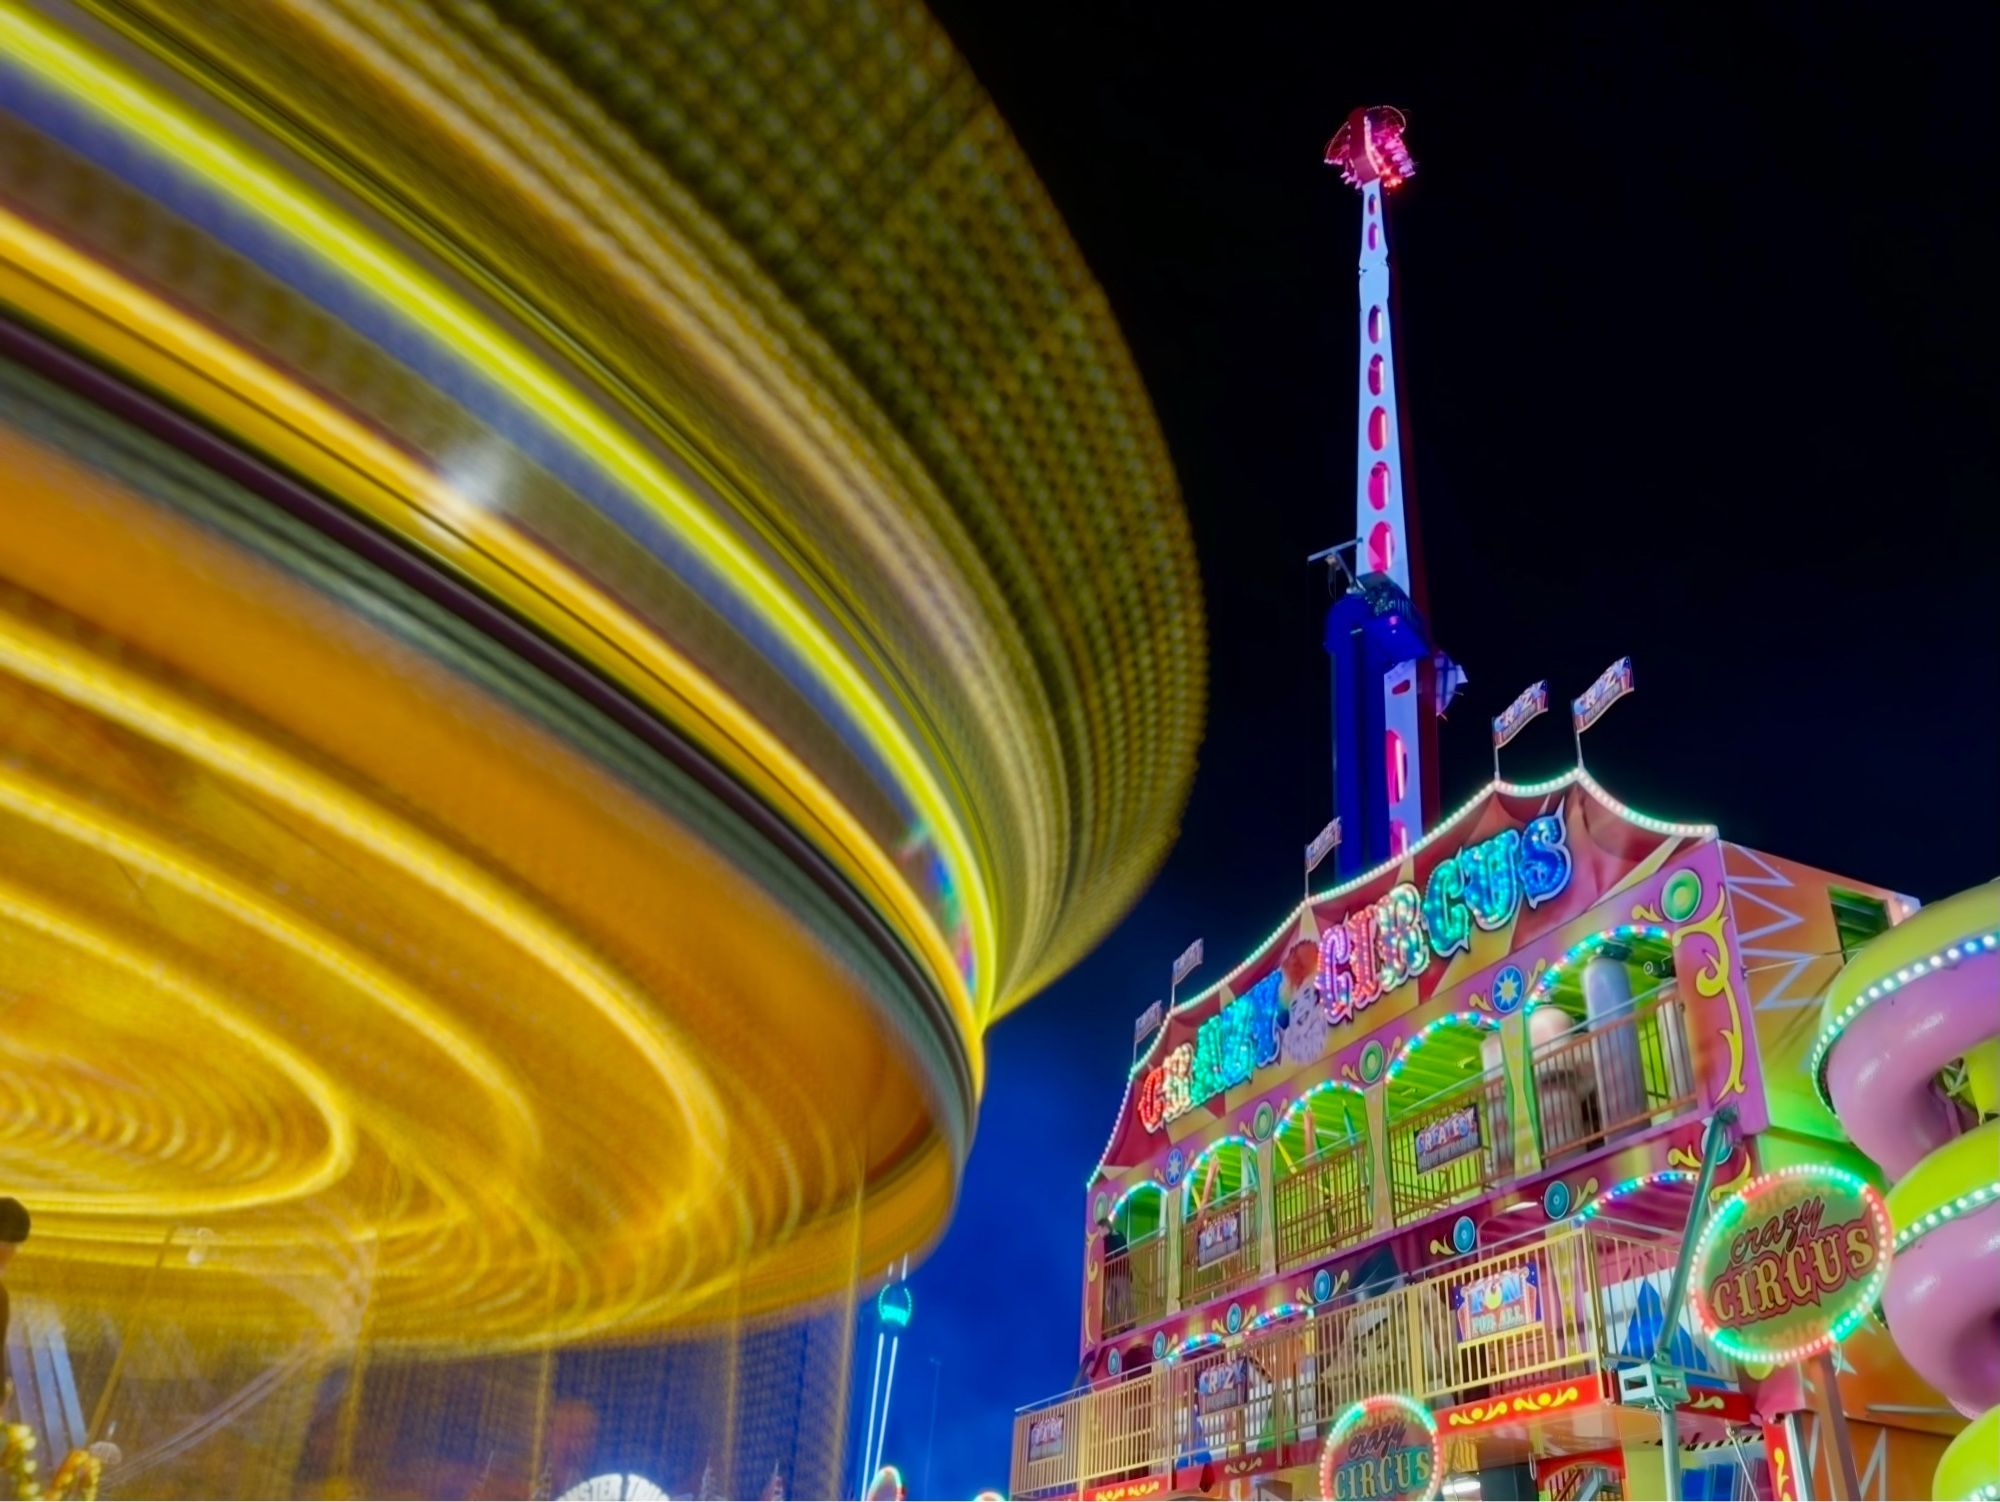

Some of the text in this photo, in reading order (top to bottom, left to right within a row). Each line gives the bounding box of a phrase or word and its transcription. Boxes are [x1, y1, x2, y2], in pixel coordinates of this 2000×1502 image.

[1138, 797, 1572, 1133] CRAZY CIRCUS
[1730, 1196, 1825, 1265] crazy
[1712, 1228, 1875, 1322] CIRCUS
[1348, 1421, 1407, 1459] crazy
[1333, 1451, 1431, 1500] CIRCUS
